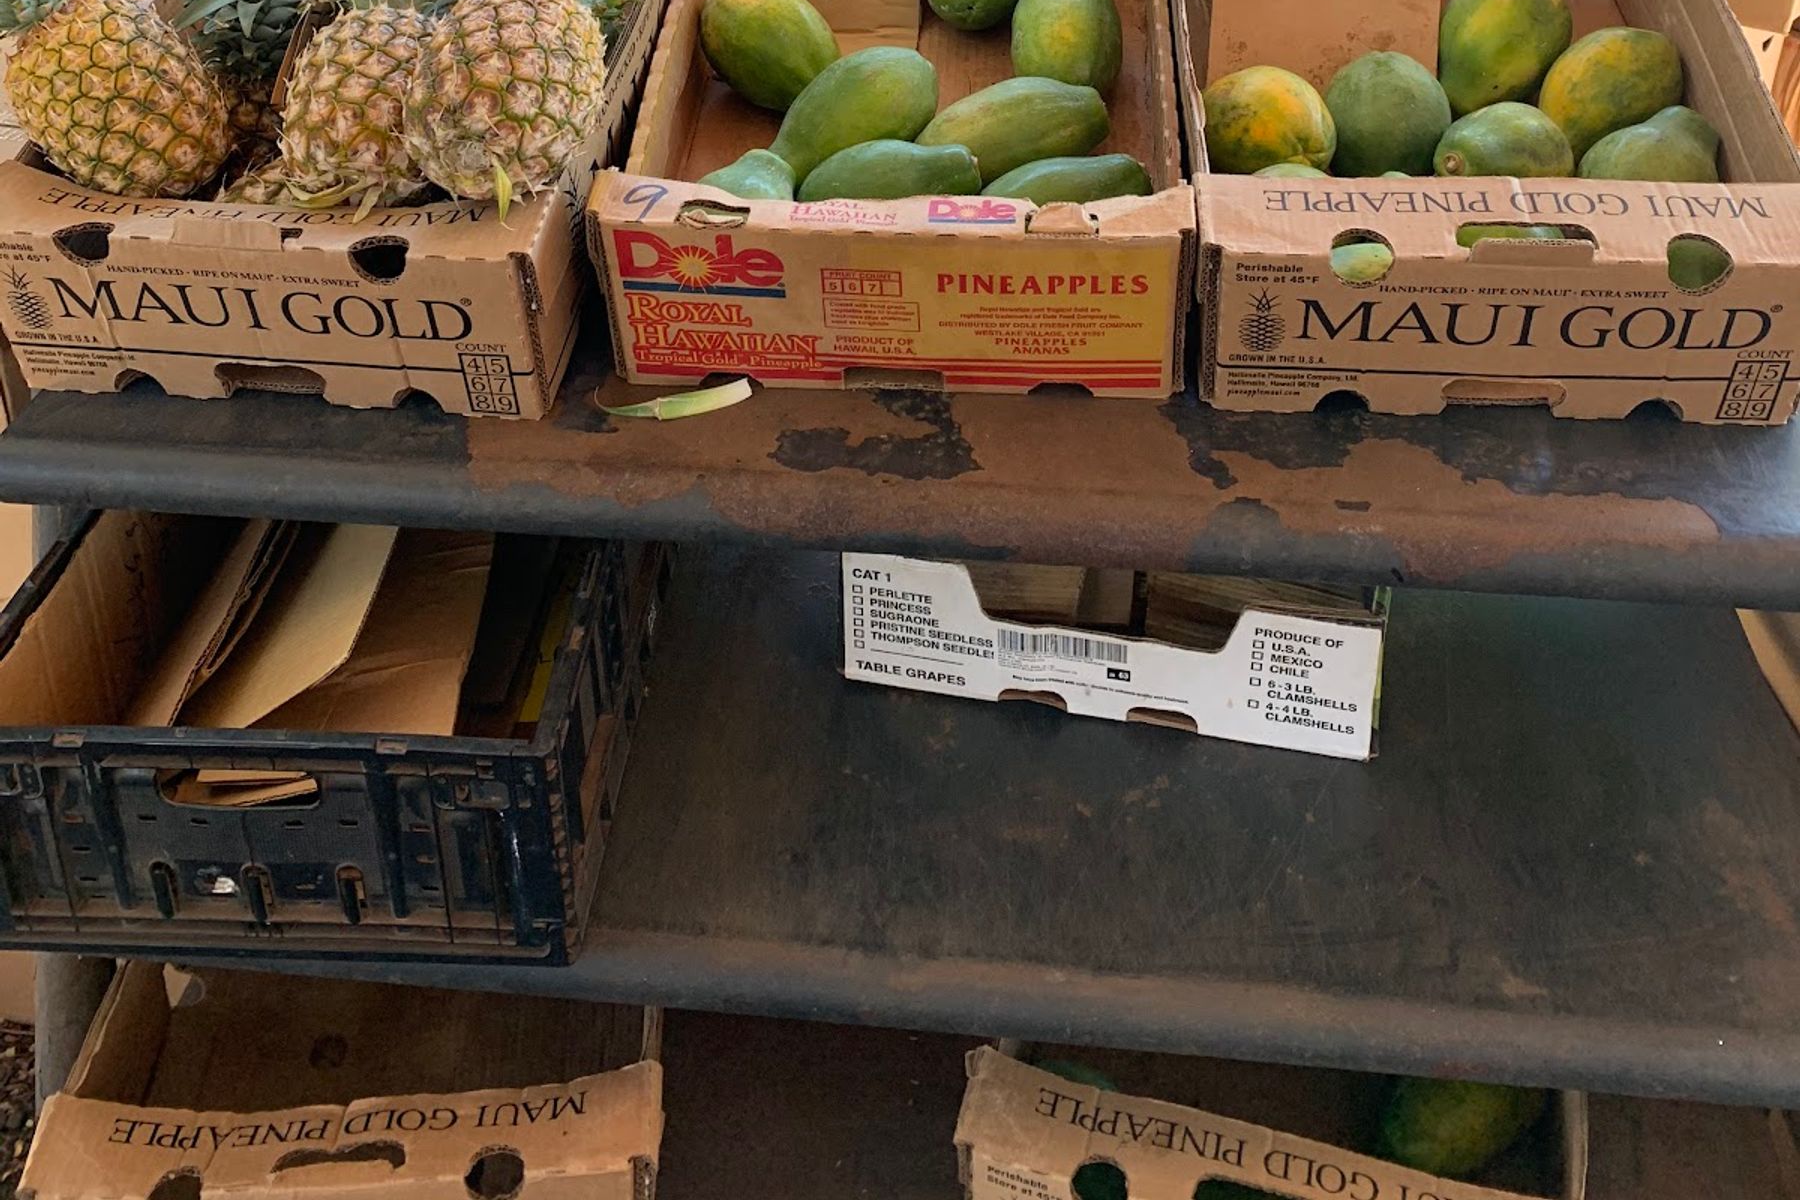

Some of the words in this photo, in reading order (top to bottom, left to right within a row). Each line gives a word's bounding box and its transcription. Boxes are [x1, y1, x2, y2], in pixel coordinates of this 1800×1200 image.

[928, 199, 1017, 222] Dole
[1264, 190, 1494, 213] PINEAPPLE
[1510, 191, 1629, 216] GOLD
[1643, 194, 1773, 218] MAUI
[378, 205, 488, 226] MAUI
[613, 229, 786, 288] Dole
[1236, 263, 1304, 273] Perishable
[193, 269, 220, 278] RIPE
[282, 275, 319, 286] EXTRA
[322, 279, 360, 288] SWEET
[829, 282, 838, 291] 5
[849, 283, 857, 291] 6
[868, 284, 877, 292] 7
[937, 274, 1150, 295] PINEAPPLES
[1235, 273, 1269, 282] Store
[1273, 275, 1285, 283] at
[1379, 284, 1468, 295] HAND-PICKED
[1478, 286, 1508, 296] RIPE
[1510, 287, 1531, 296] ON
[1580, 289, 1621, 299] EXTRA
[1625, 290, 1669, 300] SWEET
[43, 276, 271, 331] MAUI
[624, 292, 753, 327] ROYAL
[1292, 298, 1545, 347] MAUI
[455, 342, 507, 352] COUNT
[632, 321, 817, 355] HAWAIIAN
[835, 335, 893, 346] PRODUCT
[897, 338, 914, 346] OF
[995, 337, 1087, 346] PINEAPPLES
[1012, 346, 1070, 355] ANANAS
[1228, 354, 1263, 363] GROWN
[1266, 355, 1276, 363] IN
[1280, 355, 1296, 363] THE
[1736, 350, 1793, 360] COUNT
[466, 358, 481, 373] 4
[489, 358, 504, 373] 5
[637, 351, 700, 367] Tropical
[702, 354, 739, 366] Gold
[750, 354, 824, 370] Pineapple
[1737, 364, 1755, 380] 4
[1763, 364, 1781, 380] 5
[471, 377, 487, 392] 6
[493, 377, 508, 393] 7
[1731, 383, 1748, 399] 6
[1758, 383, 1776, 399] 7
[475, 395, 491, 411] 8
[497, 396, 513, 412] 9
[1723, 401, 1742, 417] 8
[1750, 402, 1769, 417] 9
[852, 568, 881, 582] CAT
[885, 572, 892, 582] 1
[869, 586, 932, 604] PERLETTE
[869, 597, 932, 616] PRINCESS
[870, 608, 939, 628] SUGRAONE
[870, 619, 927, 638] PRISTINE
[928, 628, 994, 648] SEEDLESS
[870, 630, 941, 650] THOMPSON
[1255, 627, 1322, 647] PRODUCE
[1325, 638, 1344, 649] OF
[1271, 642, 1311, 657] U.S.A.
[1270, 653, 1323, 669] MEXICO
[856, 659, 902, 677] TABLE
[905, 666, 966, 687] GRAPES
[1269, 664, 1310, 679] CHILE
[1295, 682, 1316, 696] LB.
[1267, 689, 1358, 713] CLAMSHELLS
[1292, 705, 1314, 718] LB.
[1265, 711, 1355, 735] CLAMSHELLS
[474, 1090, 588, 1127] MAUI
[344, 1105, 458, 1133] GOLD
[1034, 1087, 1248, 1168] PINEAPPLE
[108, 1116, 330, 1149] PINEAPPLE
[987, 1165, 1049, 1191] Perishable
[1263, 1149, 1380, 1200] GOLD
